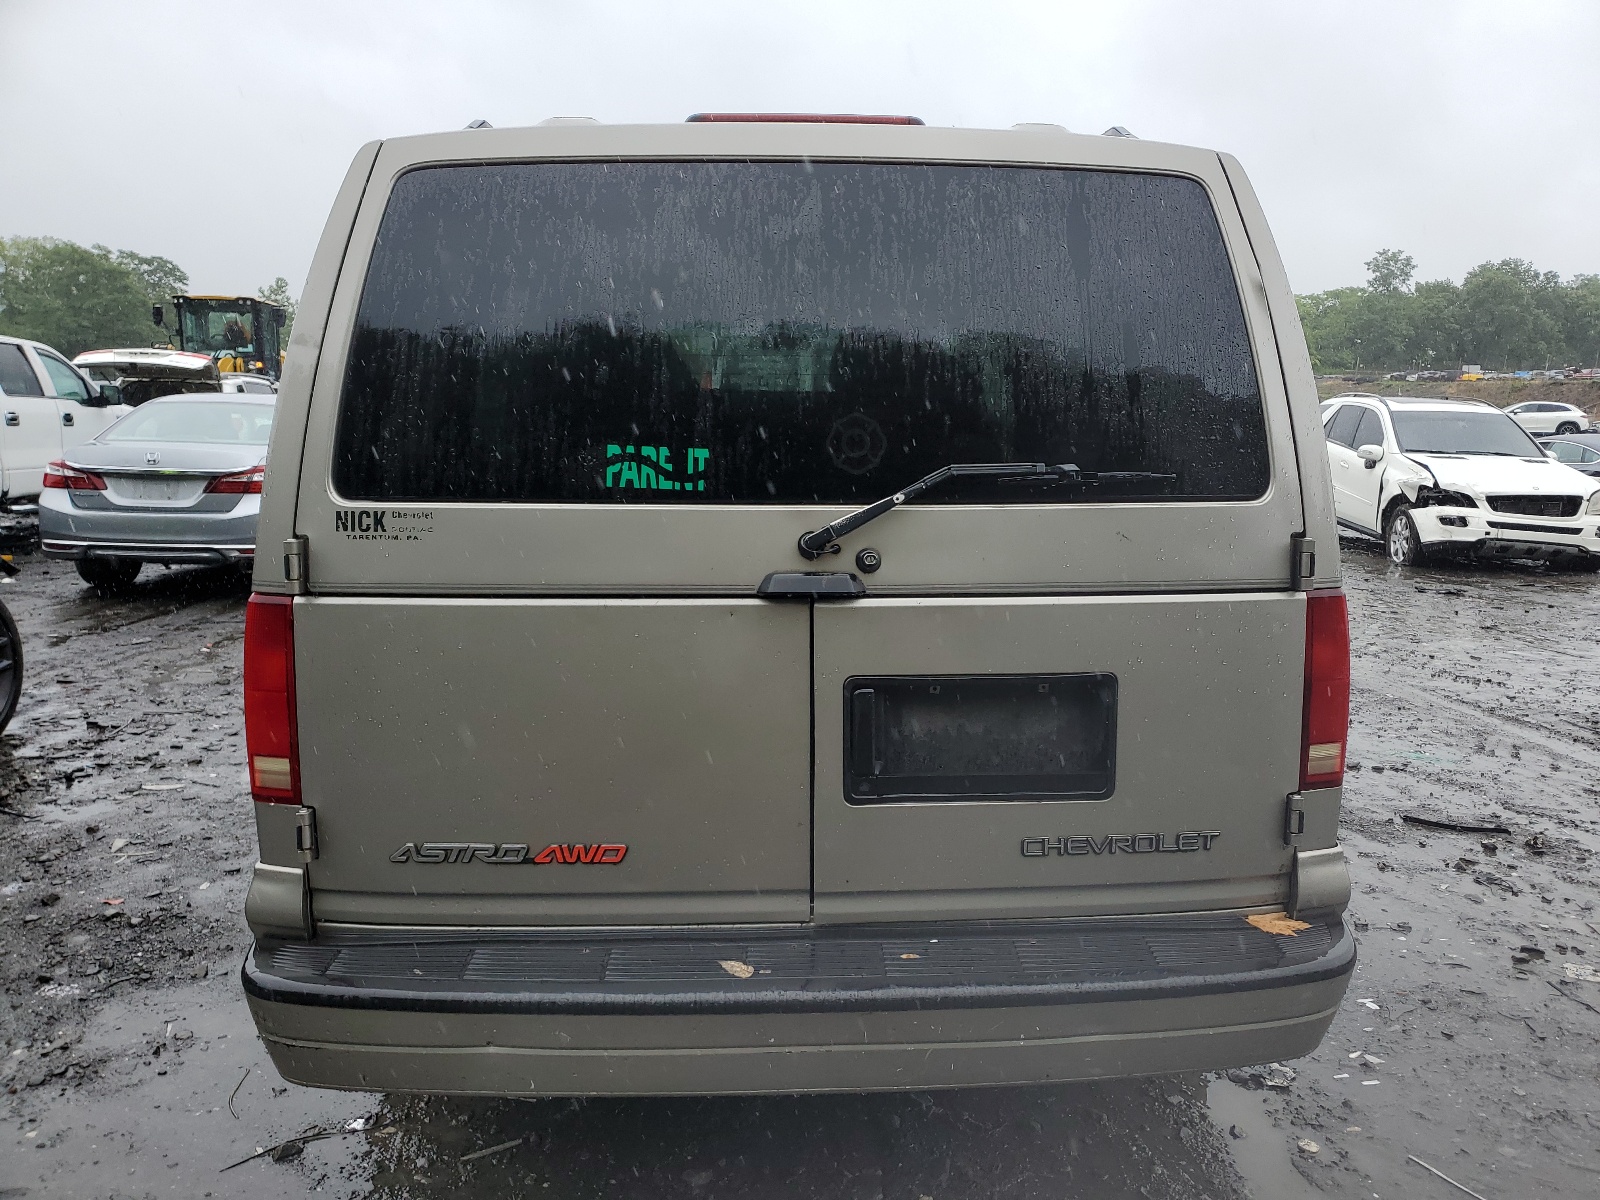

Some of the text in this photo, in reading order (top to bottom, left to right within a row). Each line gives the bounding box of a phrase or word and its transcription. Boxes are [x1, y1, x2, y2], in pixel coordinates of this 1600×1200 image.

[335, 510, 387, 532] NICK
[389, 842, 629, 864] ASTRO AWD
[1021, 830, 1221, 857] CHEVROLET
